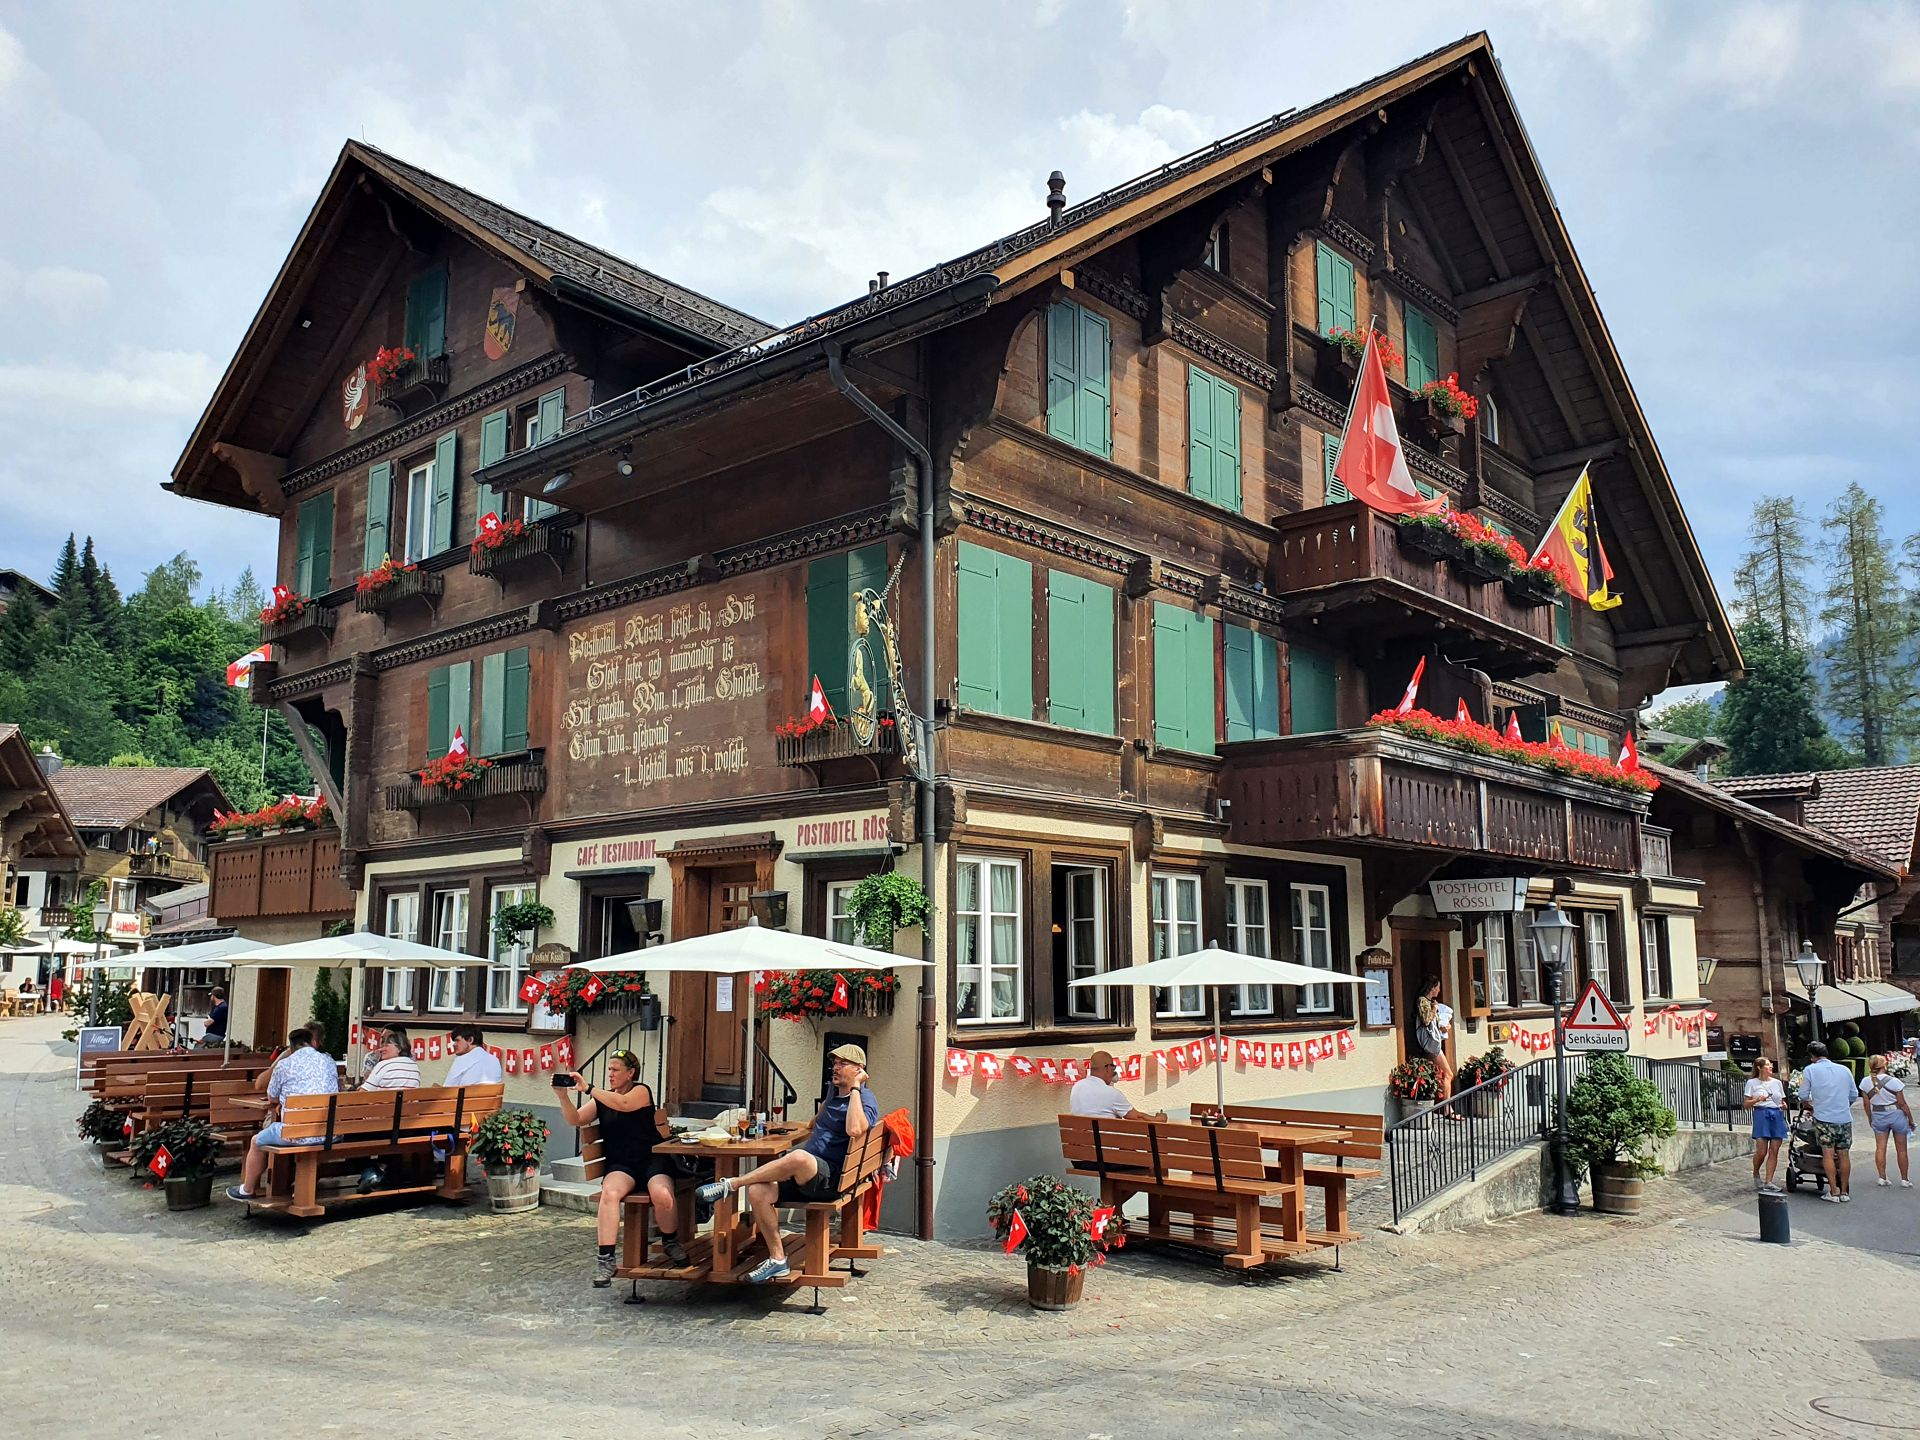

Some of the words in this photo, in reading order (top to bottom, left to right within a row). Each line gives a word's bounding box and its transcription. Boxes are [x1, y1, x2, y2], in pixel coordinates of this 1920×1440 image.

[624, 614, 664, 650] Rössli
[797, 819, 857, 846] POSTHOTEL
[577, 844, 598, 866] CAFÉ
[602, 839, 656, 864] RESTAURANT
[1437, 882, 1507, 894] POSTHOTEL
[1453, 896, 1495, 908] RÖSSLI
[1568, 1033, 1623, 1045] Senksäulen
